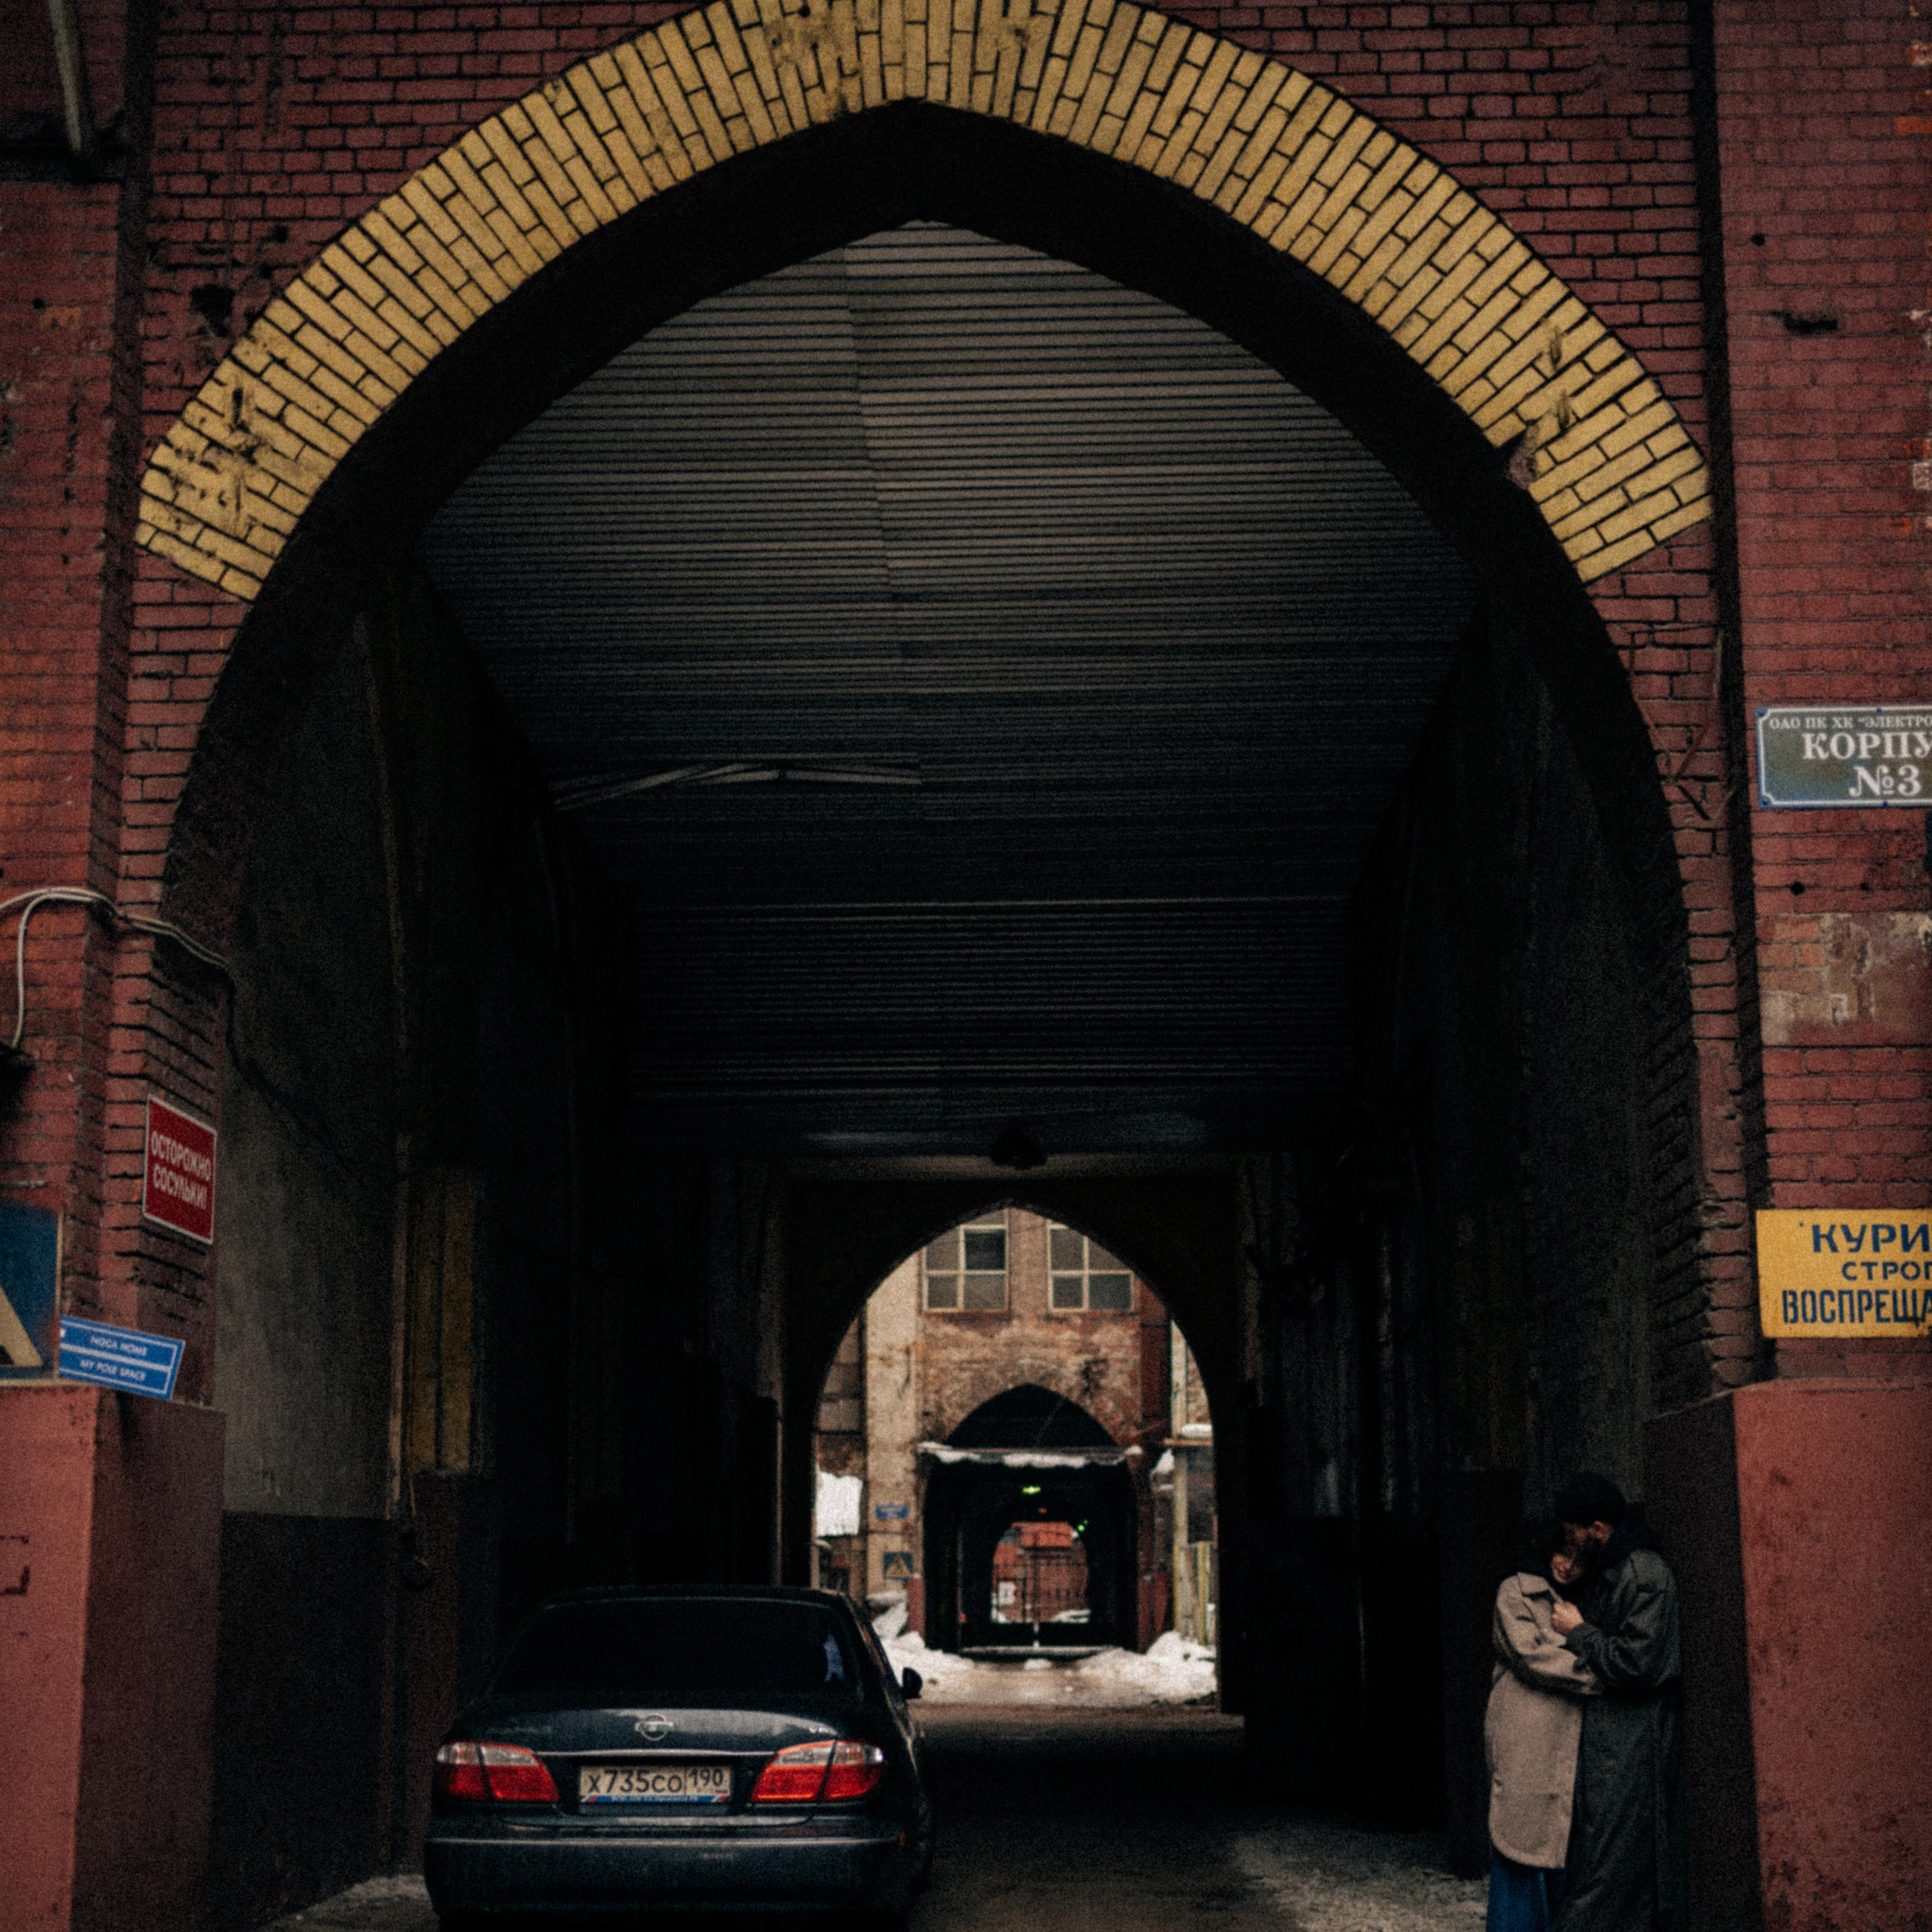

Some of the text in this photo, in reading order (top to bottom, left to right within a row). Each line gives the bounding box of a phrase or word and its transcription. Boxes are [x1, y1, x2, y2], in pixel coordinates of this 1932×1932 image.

[1769, 717, 1801, 729] ОАО
[1805, 717, 1826, 728] ПК
[1832, 716, 1854, 728] ХК
[1801, 732, 1932, 760] КОРПУ
[1849, 764, 1921, 797] №3
[152, 1131, 211, 1181] ОСТОРОЖНО
[1812, 1223, 1930, 1253] КУРИ
[688, 1767, 724, 1786] 190
